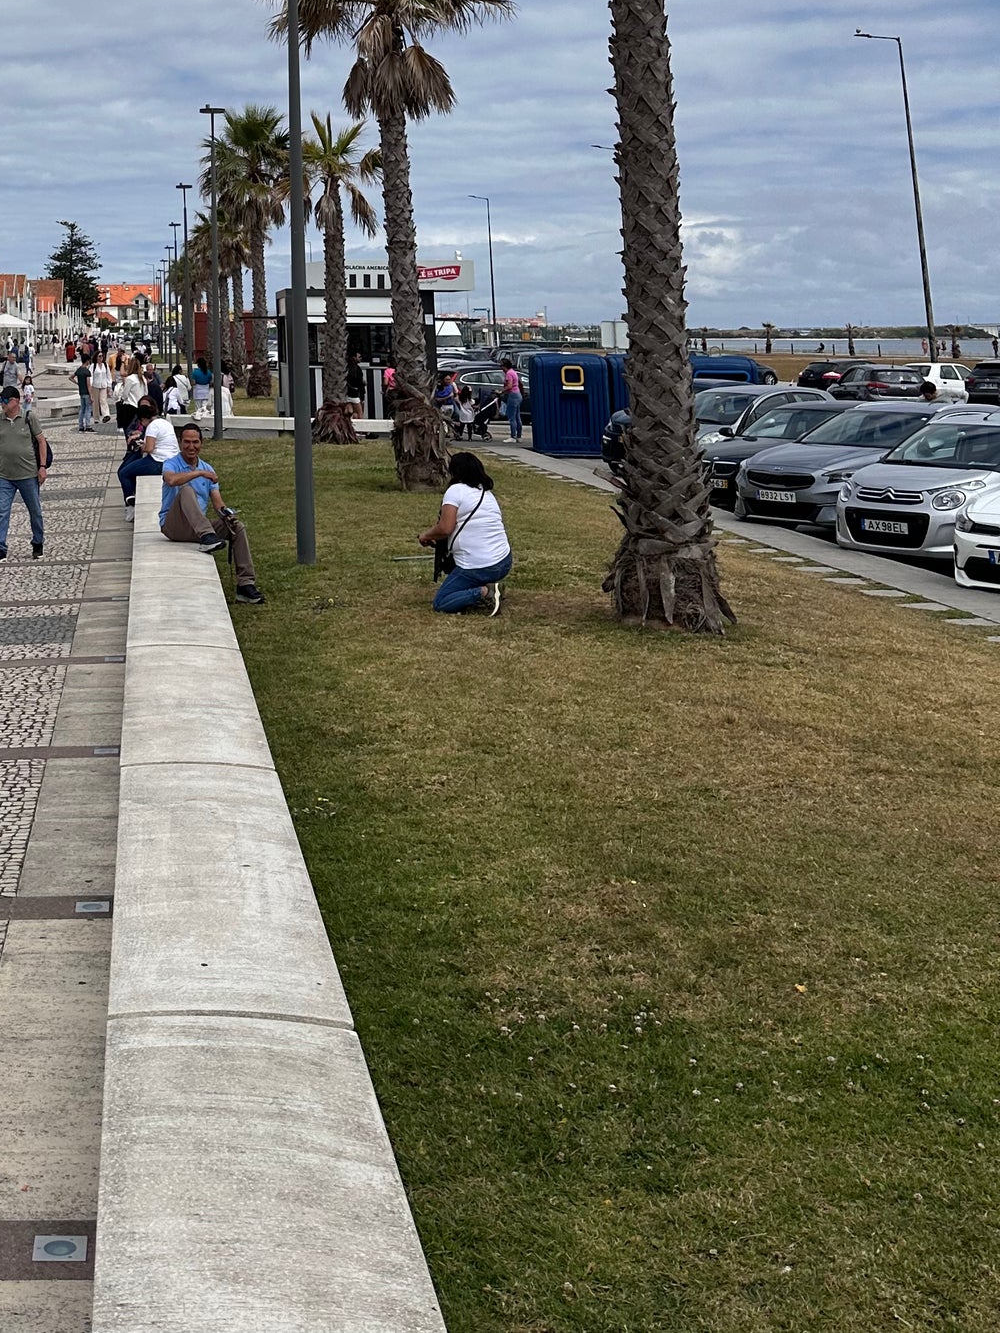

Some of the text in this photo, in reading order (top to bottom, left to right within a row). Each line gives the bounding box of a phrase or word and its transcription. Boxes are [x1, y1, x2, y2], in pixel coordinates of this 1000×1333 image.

[434, 267, 456, 277] TRIPA
[760, 490, 794, 501] 8932 LSY
